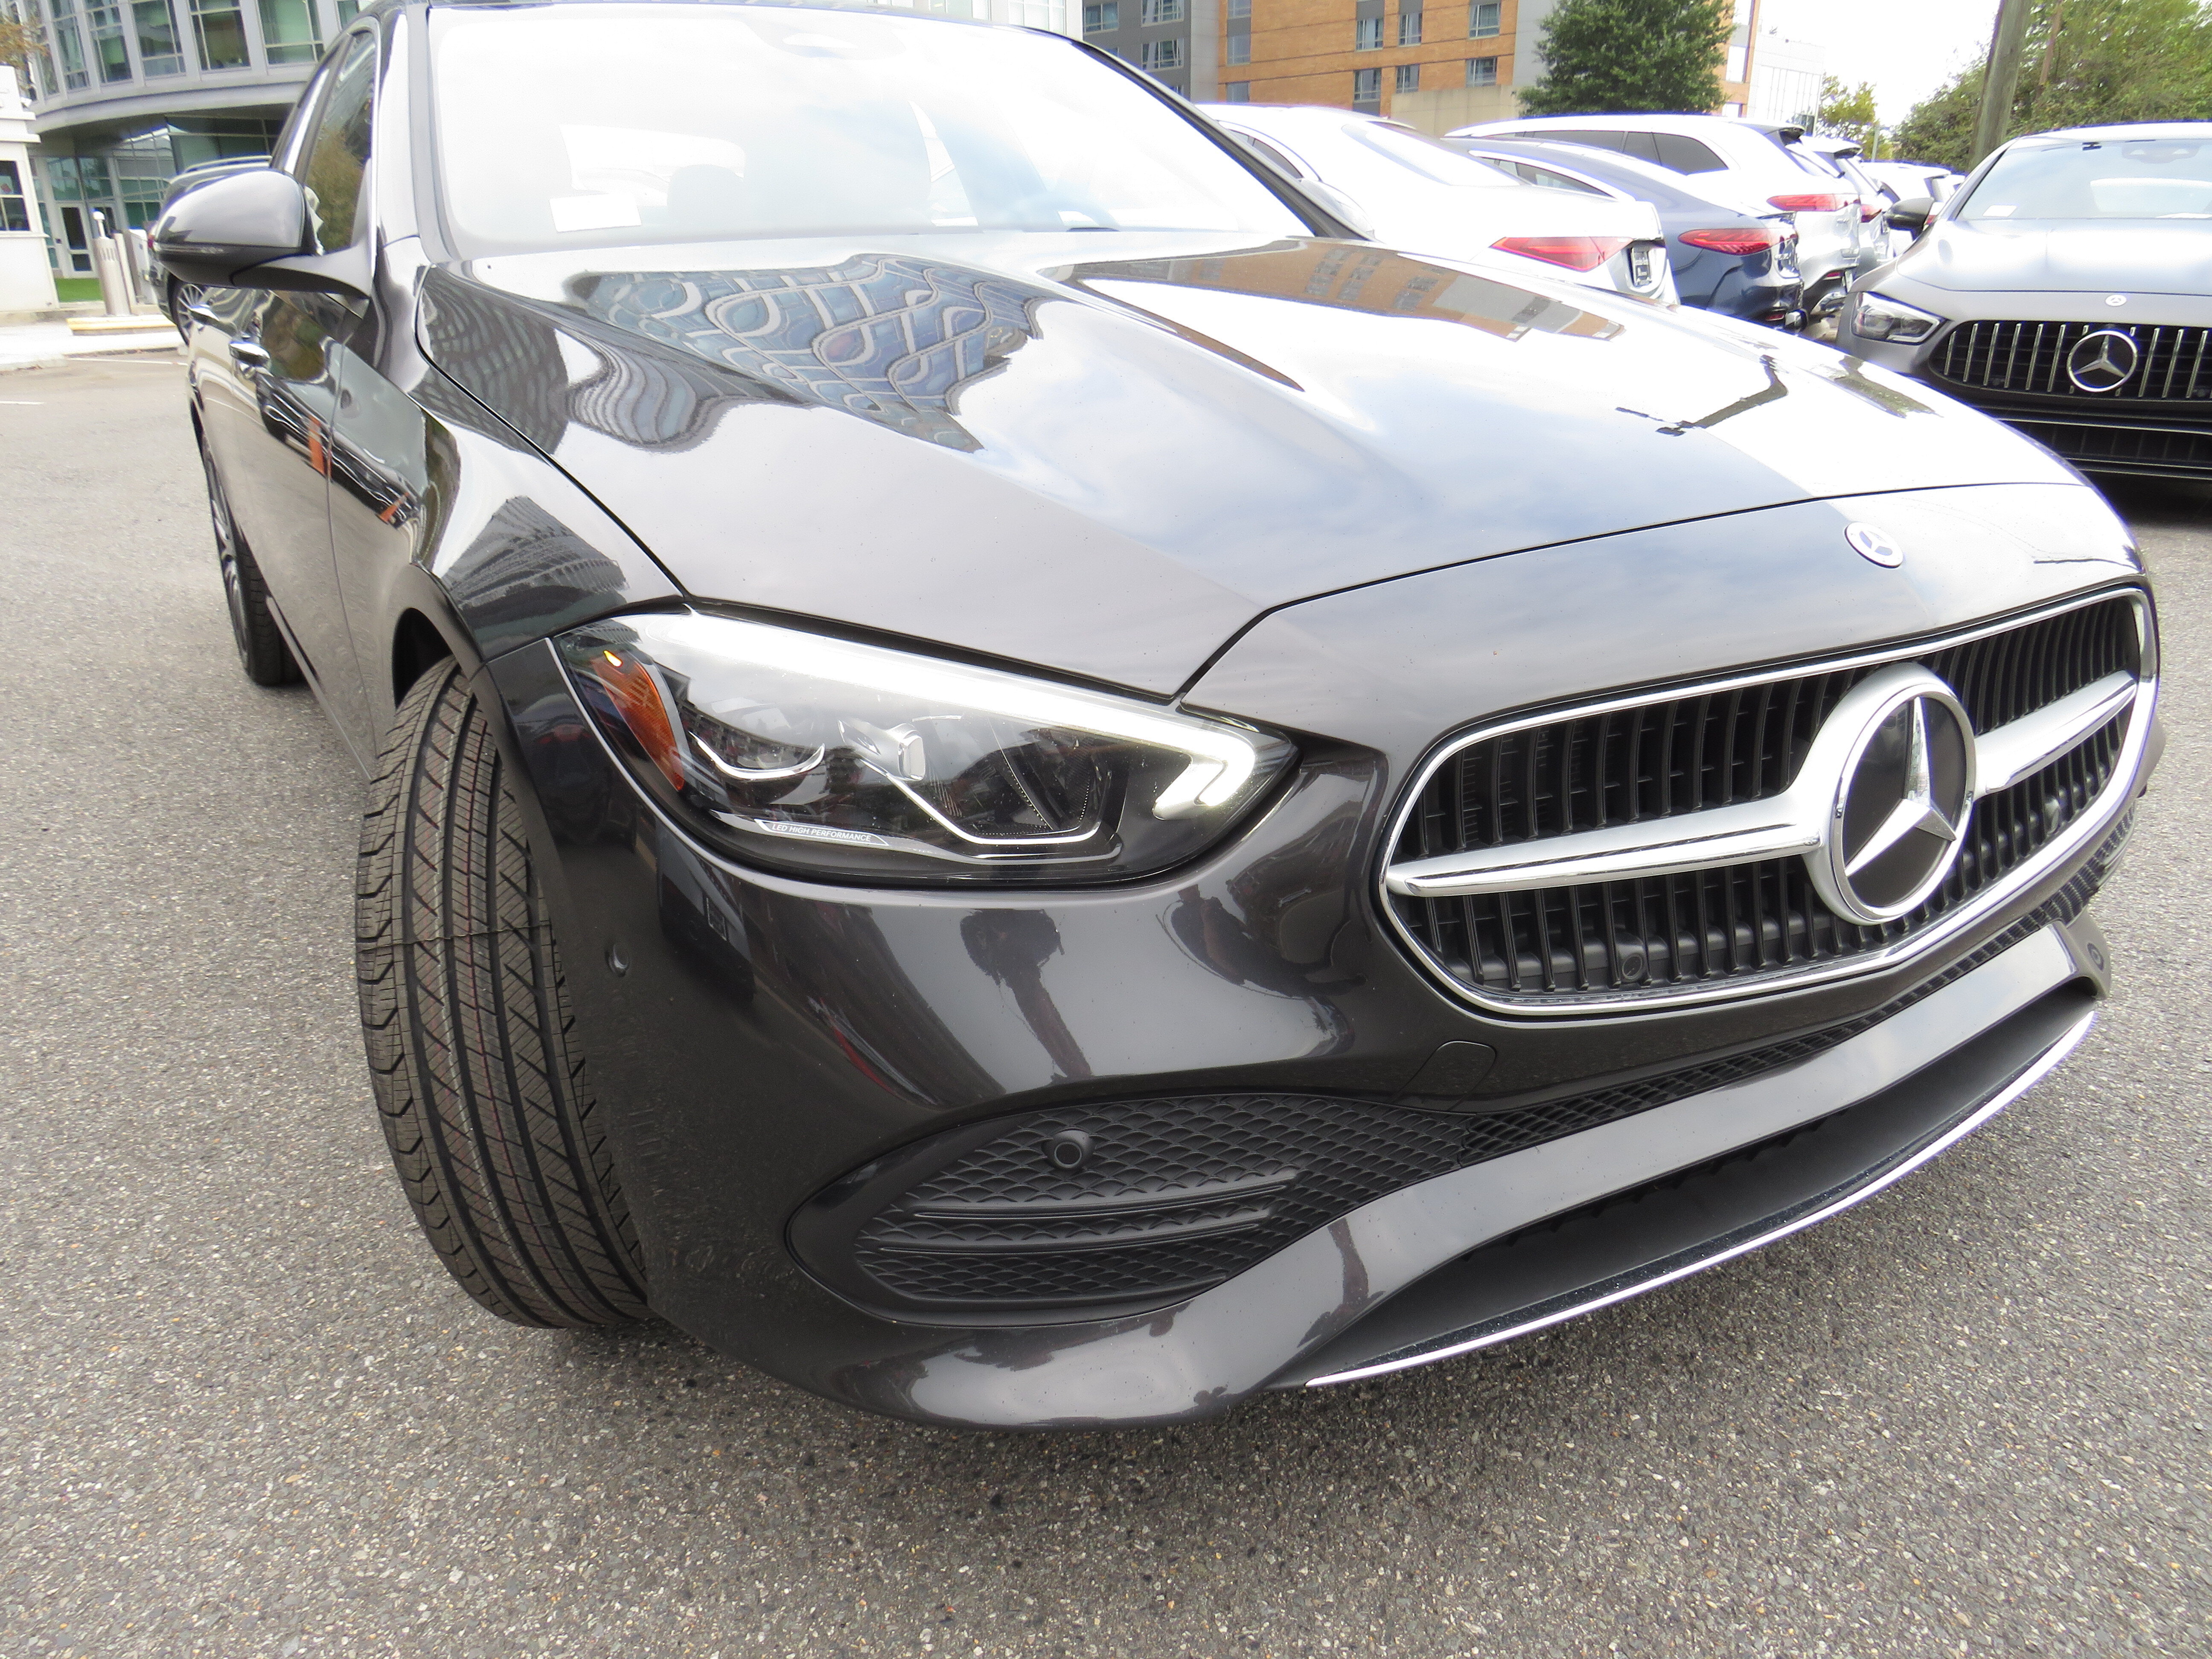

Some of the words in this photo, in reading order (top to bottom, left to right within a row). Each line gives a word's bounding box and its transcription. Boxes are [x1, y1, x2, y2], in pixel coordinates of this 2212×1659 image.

[772, 824, 788, 832] LED
[789, 826, 809, 834] HIGH
[811, 829, 871, 841] PERFORMANCE
